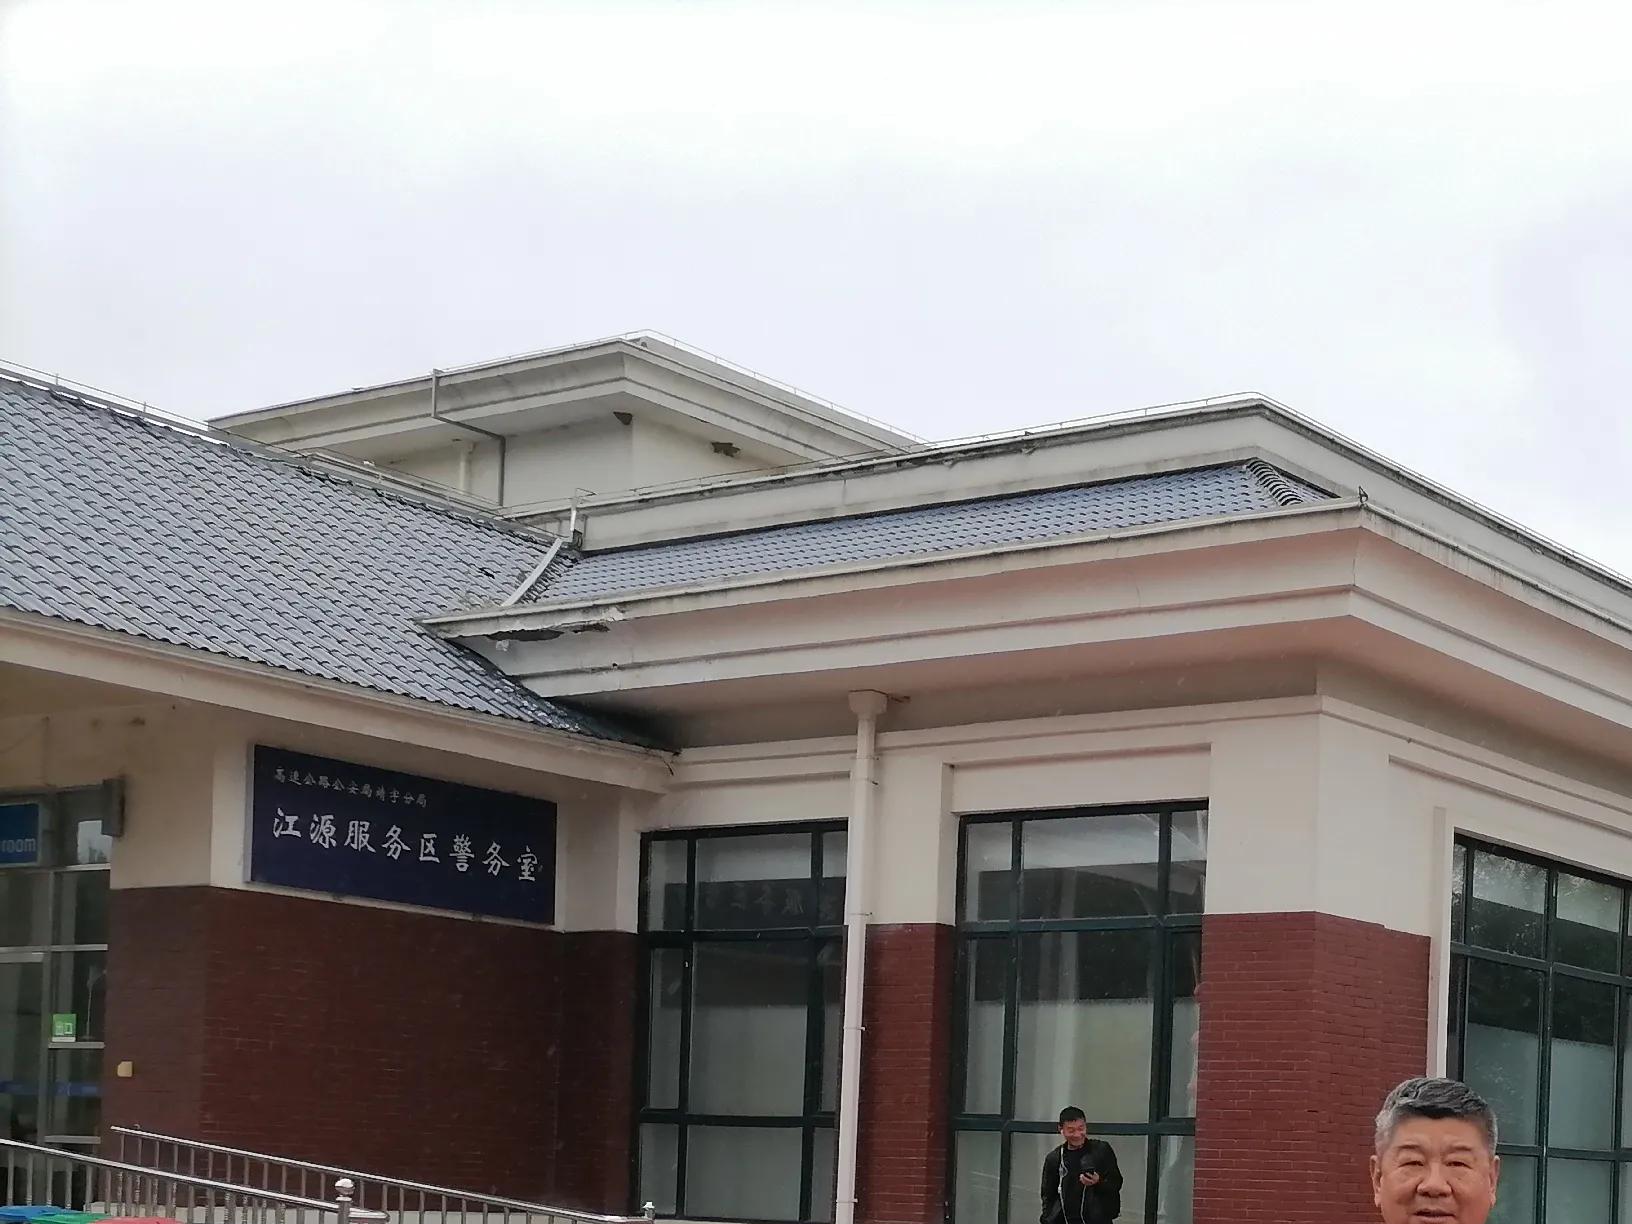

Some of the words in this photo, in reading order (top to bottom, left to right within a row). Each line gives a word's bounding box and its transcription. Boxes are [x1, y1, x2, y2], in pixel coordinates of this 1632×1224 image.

[271, 807, 540, 882] 江源服务区警务室
